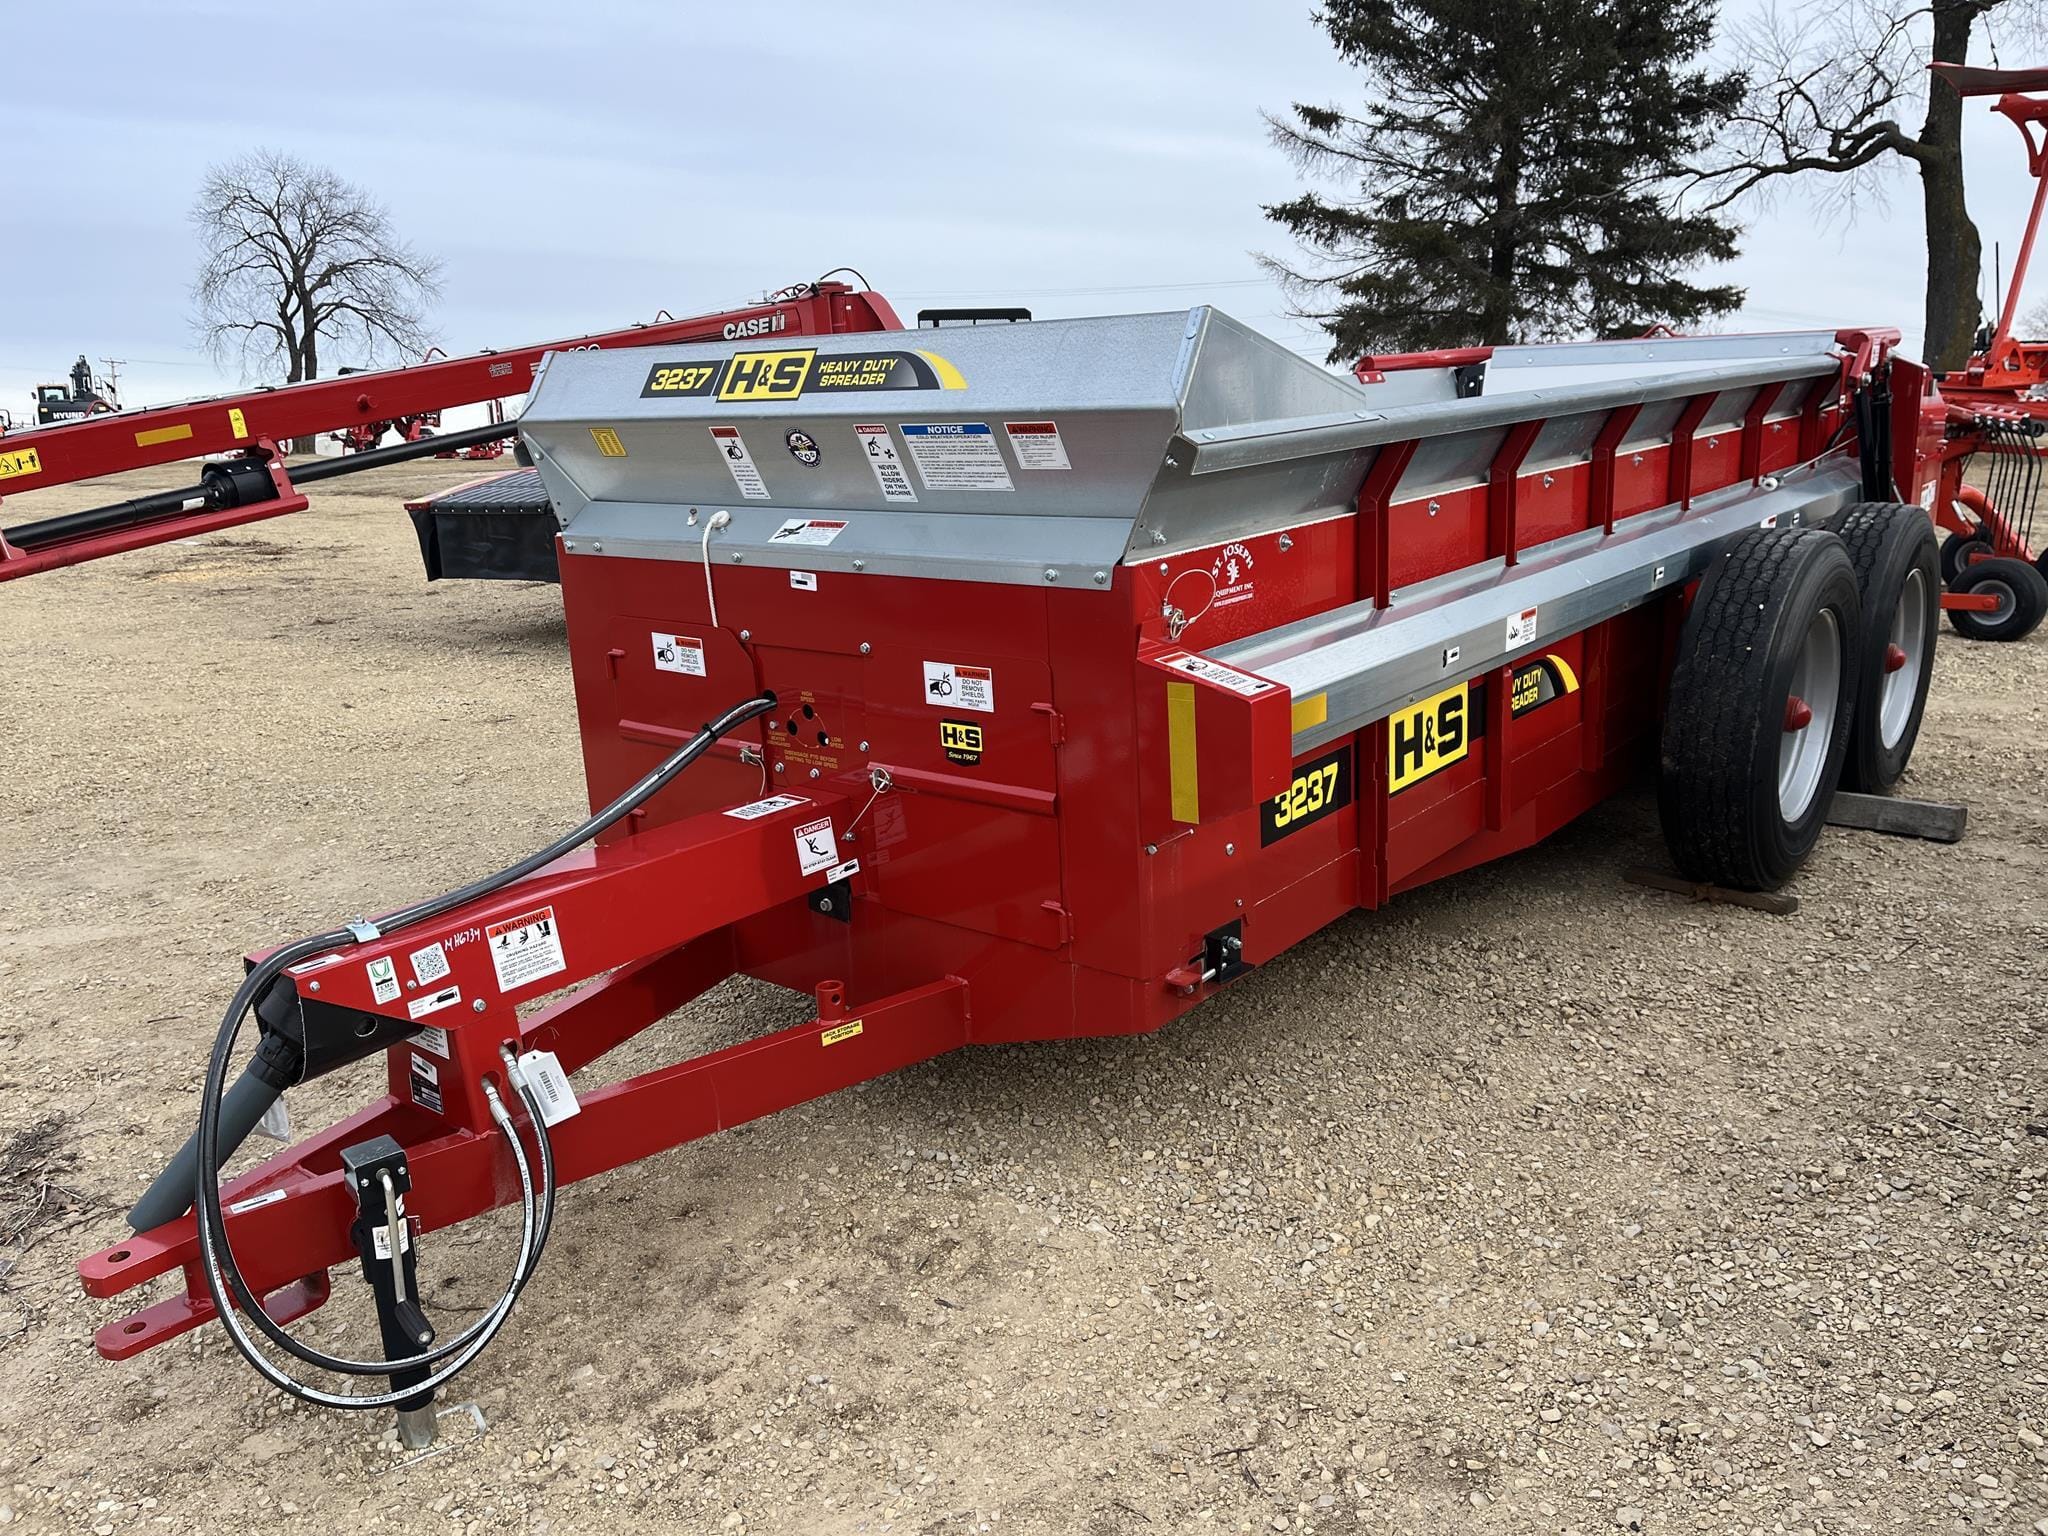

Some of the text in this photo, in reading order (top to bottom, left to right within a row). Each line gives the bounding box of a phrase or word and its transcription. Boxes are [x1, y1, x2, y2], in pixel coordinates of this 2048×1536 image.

[723, 320, 769, 341] CASE
[818, 358, 899, 374] HEAVY DUTY
[651, 355, 808, 395] 3237 H&S
[819, 372, 887, 387] SPREADER
[53, 411, 95, 420] HYUND
[927, 426, 964, 434] NOTICE
[1212, 543, 1254, 578] ST. JOSEPH
[1213, 581, 1254, 597] QUIPMENT INC
[1523, 668, 1543, 689] DUTY
[962, 691, 985, 699] SHIELDS
[1511, 686, 1539, 711] READER
[829, 741, 845, 749] SPEED
[942, 725, 980, 749] H&S
[1394, 693, 1464, 781] H&S
[948, 751, 978, 761] Since 1967
[823, 761, 838, 769] SPEED
[1274, 761, 1339, 828] 3237
[803, 820, 830, 834] DANGER
[502, 911, 546, 934] WARNING
[505, 947, 529, 959] CRUSHING
[376, 981, 395, 992] FEMA
[823, 1021, 860, 1039] JACK STORAGE
[830, 1029, 854, 1041] POSITION
